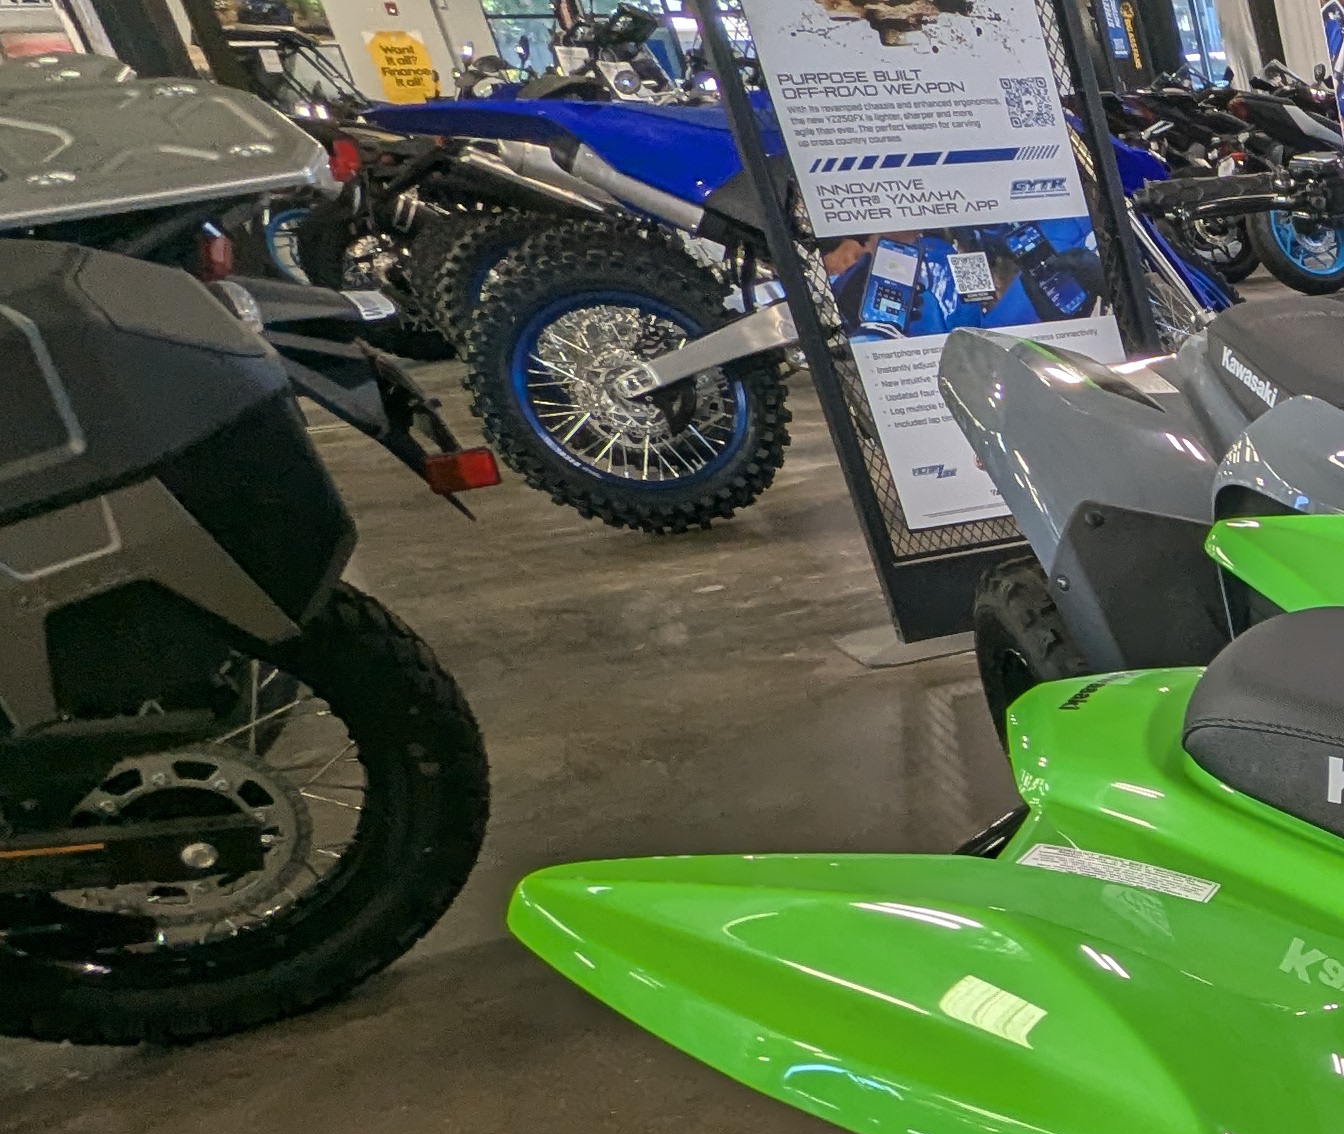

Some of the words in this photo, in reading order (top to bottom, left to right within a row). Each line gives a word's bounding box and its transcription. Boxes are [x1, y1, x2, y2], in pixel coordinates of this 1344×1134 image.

[381, 66, 432, 77] Finance
[777, 71, 869, 85] PURPOSE
[873, 69, 921, 82] BUILT
[782, 85, 878, 99] OFF-ROAD
[883, 81, 965, 95] WEAPON
[896, 101, 911, 109] and
[858, 124, 874, 132] The
[875, 123, 905, 132] perfect
[906, 122, 937, 130] weapon
[835, 137, 867, 145] country
[816, 179, 924, 196] INNOVATIVE
[1010, 177, 1067, 193] GYTR
[886, 190, 966, 205] YAMAHA
[825, 208, 892, 223] POWER
[897, 203, 960, 218] TUNER
[965, 200, 999, 212] APP
[1221, 345, 1279, 409] Kawasaki
[889, 405, 905, 416] Log
